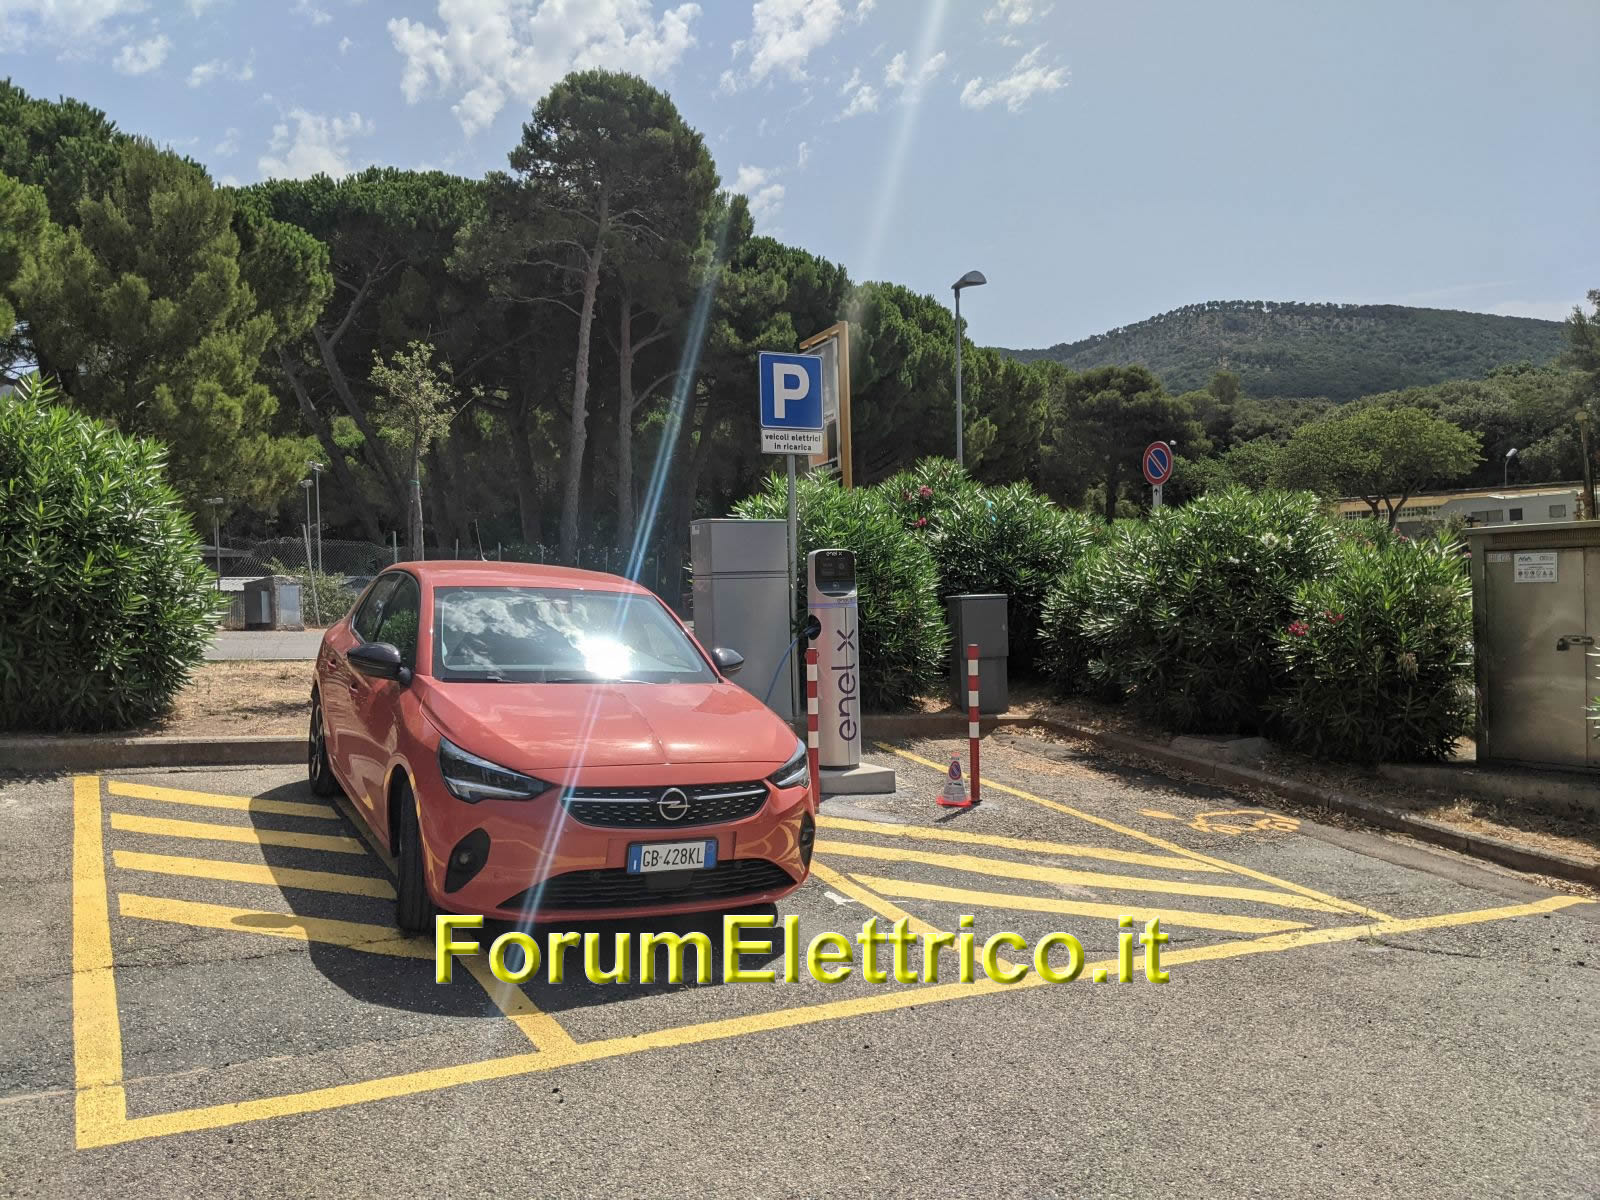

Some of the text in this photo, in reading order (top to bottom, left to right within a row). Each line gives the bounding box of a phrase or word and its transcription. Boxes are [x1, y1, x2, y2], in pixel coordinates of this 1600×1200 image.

[773, 363, 809, 418] P
[791, 434, 821, 442] elettrici
[831, 664, 857, 741] enel
